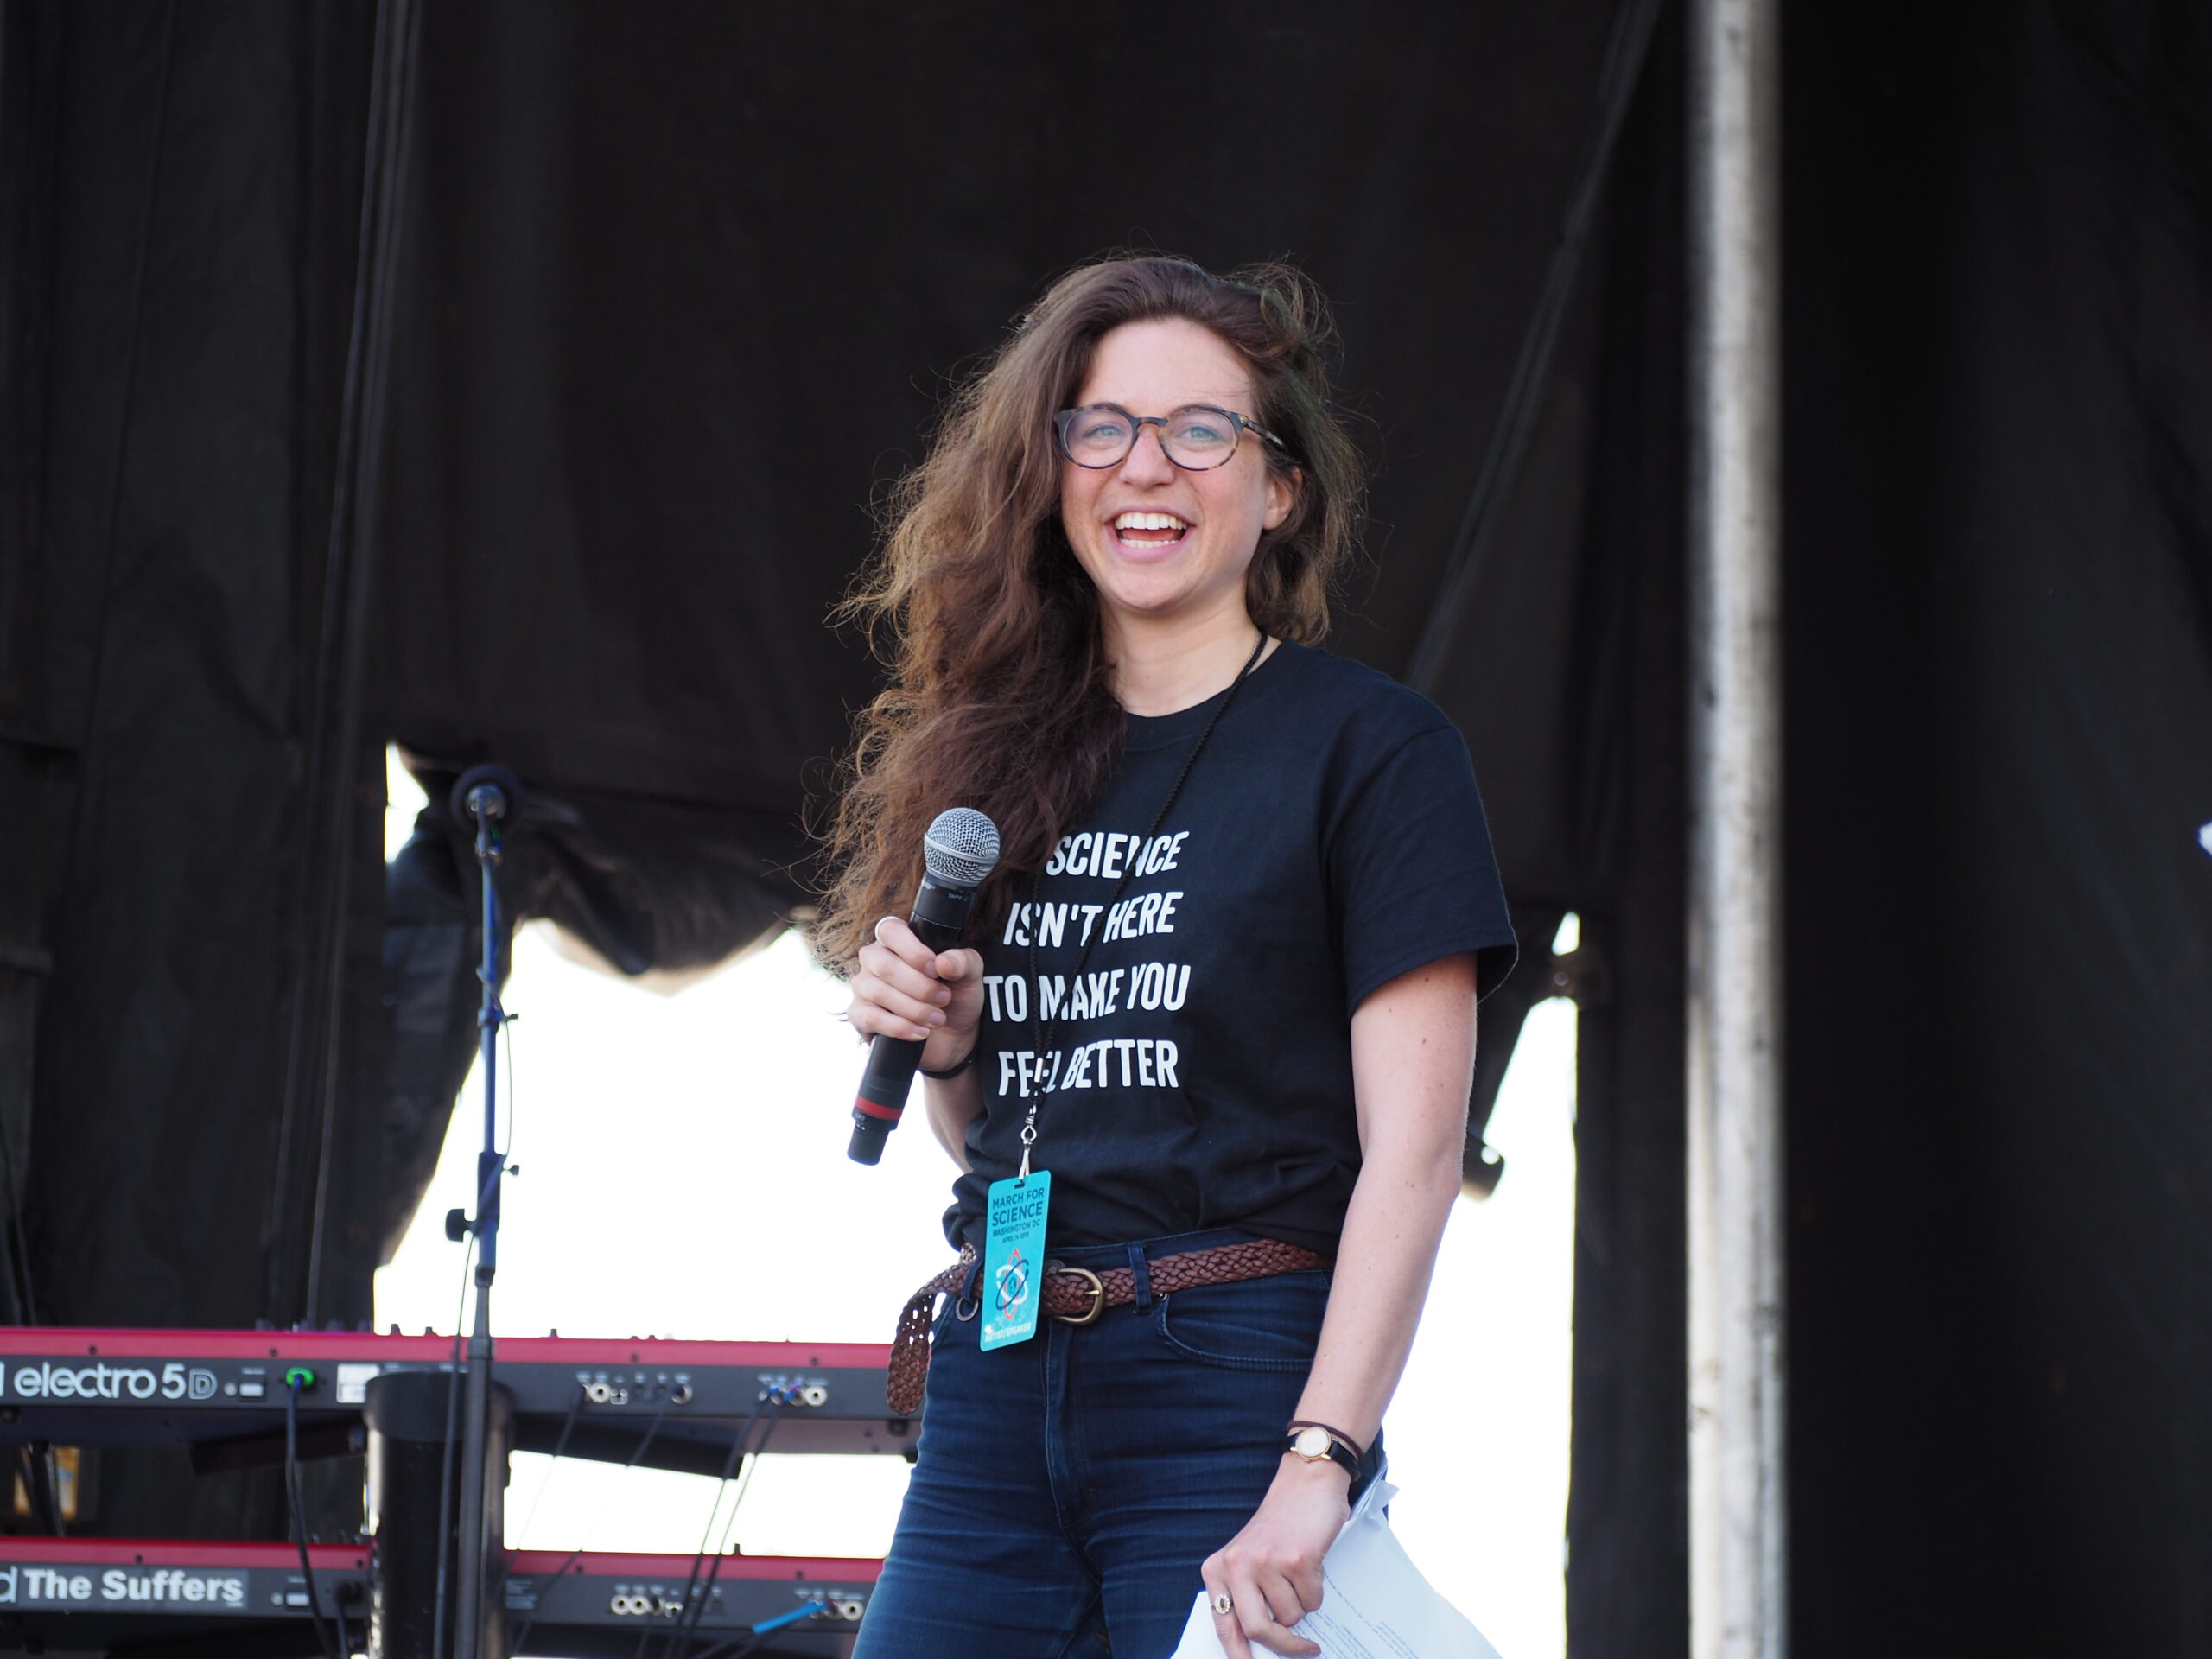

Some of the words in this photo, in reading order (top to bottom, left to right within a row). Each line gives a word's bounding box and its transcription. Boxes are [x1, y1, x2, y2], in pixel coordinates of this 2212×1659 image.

[1046, 831, 1190, 879] SCIENCE
[1003, 902, 1103, 948] ISN'T
[1103, 891, 1184, 944] HERE
[983, 975, 1028, 1022] TO
[1038, 969, 1125, 1021] MAKE
[1127, 962, 1192, 1011] YOU
[1060, 1039, 1179, 1090] BETTER
[992, 1192, 1024, 1210] MARCH
[1026, 1187, 1045, 1201] FOR
[992, 1201, 1044, 1226] SCIENCE
[992, 1220, 1032, 1237] WASHINGTON
[1032, 1218, 1041, 1228] DC
[14, 1361, 157, 1399] electro
[22, 1568, 92, 1600] The
[100, 1569, 244, 1602] Suffers
